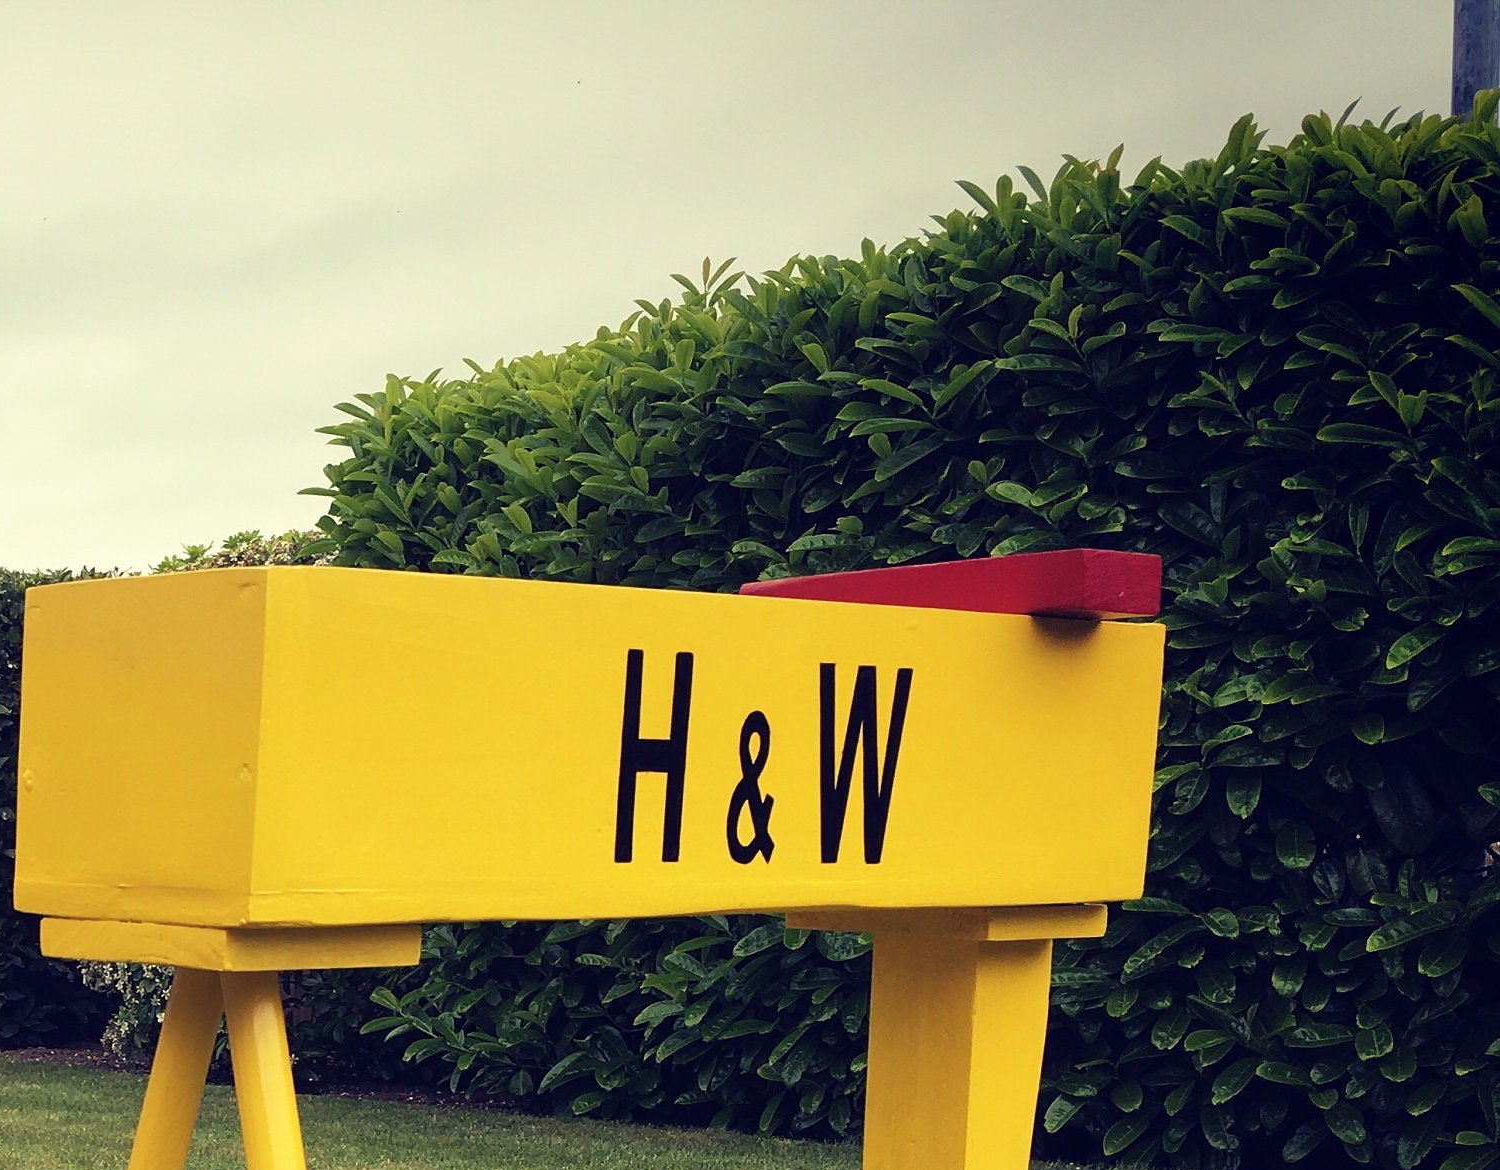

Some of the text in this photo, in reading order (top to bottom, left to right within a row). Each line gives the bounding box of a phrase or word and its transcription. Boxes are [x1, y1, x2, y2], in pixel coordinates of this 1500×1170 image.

[614, 648, 914, 864] H & W
